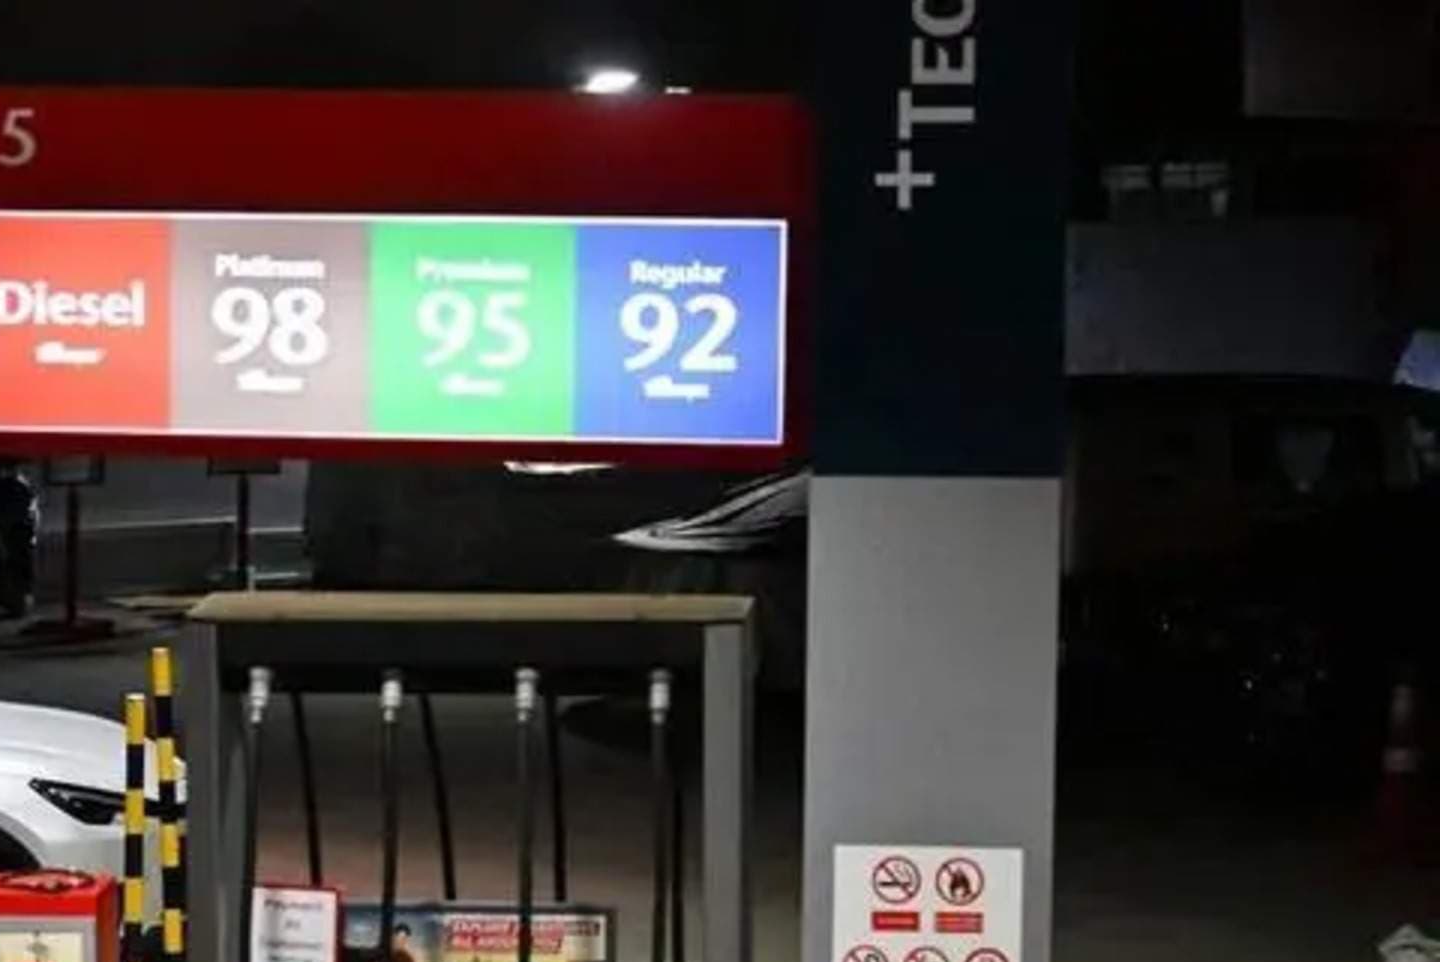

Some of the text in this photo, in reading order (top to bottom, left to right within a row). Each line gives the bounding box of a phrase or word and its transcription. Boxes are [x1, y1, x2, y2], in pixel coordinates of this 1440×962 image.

[215, 254, 326, 278] Platinum
[629, 259, 726, 288] Regular
[211, 287, 328, 365] 98
[416, 289, 532, 369] 95
[619, 292, 738, 373] 92
